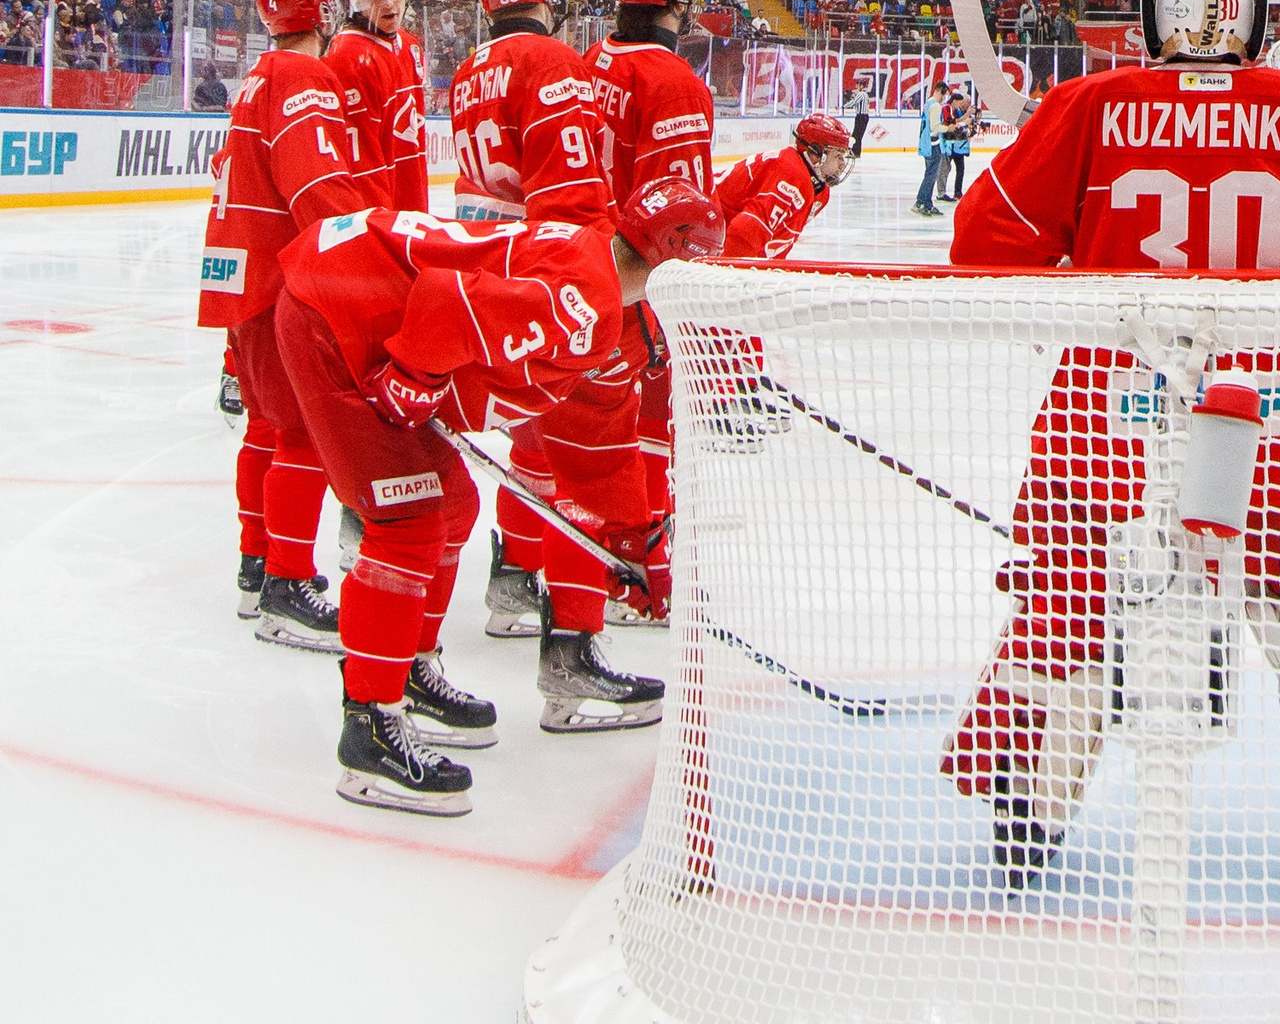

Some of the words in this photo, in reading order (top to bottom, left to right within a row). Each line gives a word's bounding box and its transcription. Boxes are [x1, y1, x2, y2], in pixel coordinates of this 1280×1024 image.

[655, 117, 708, 135] OLIMPBET
[0, 131, 78, 175] БУР
[316, 126, 339, 162] 4
[688, 243, 708, 255] CCM
